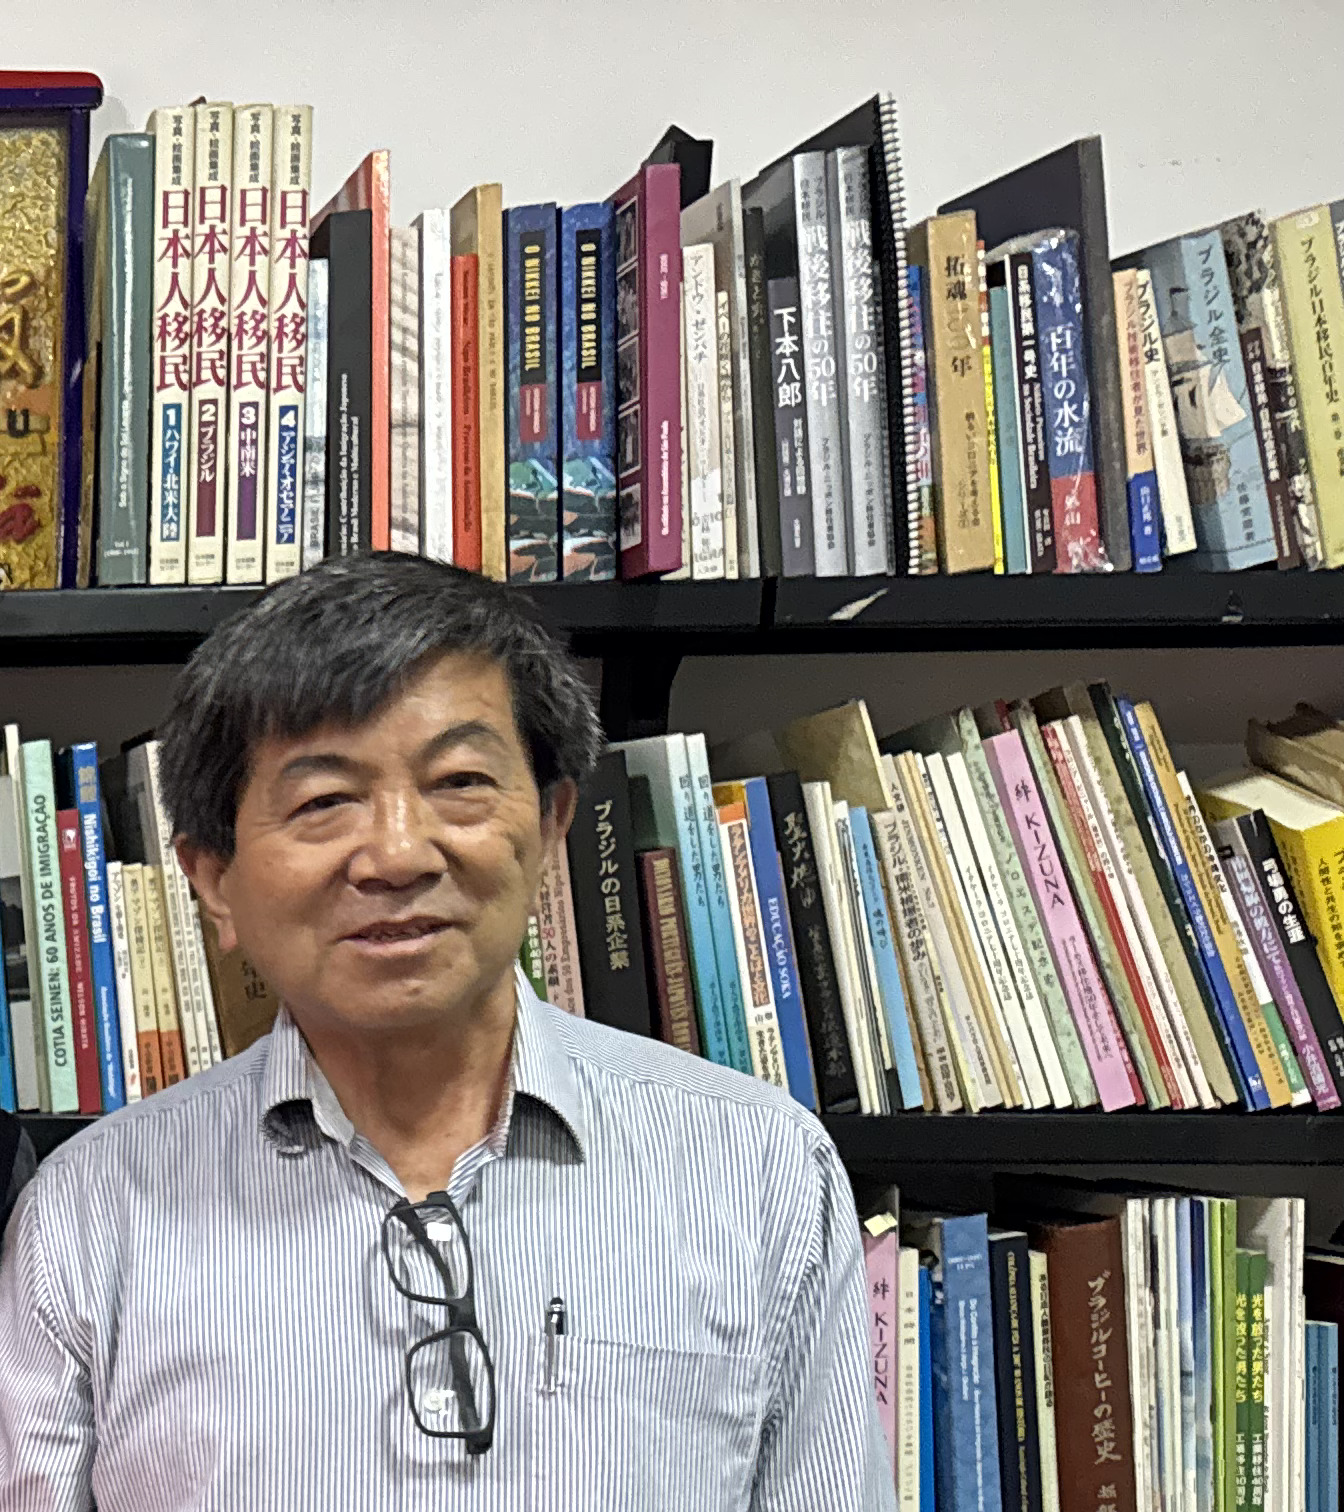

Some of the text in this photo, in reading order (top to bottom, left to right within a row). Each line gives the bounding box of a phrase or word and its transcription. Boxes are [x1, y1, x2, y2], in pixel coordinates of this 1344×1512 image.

[157, 190, 191, 392] 日本人移民
[192, 185, 228, 390] 日本人移民
[233, 186, 269, 391] 日本人移民
[524, 245, 540, 253] O
[524, 257, 540, 300] NIKKEI
[580, 243, 596, 251] O
[580, 256, 596, 299] NIKKEI
[272, 189, 309, 394] 日本人移民
[524, 304, 540, 322] NO
[580, 303, 596, 321] NO
[1137, 281, 1160, 363] ブラジル史
[524, 326, 540, 371] BRASIL
[580, 324, 596, 369] BRASIL
[773, 306, 802, 408] 下本八郎
[167, 409, 176, 425] 1
[280, 409, 296, 428] 4
[1048, 327, 1083, 456] 百年の水流
[200, 404, 216, 484] 2 ブラジル
[239, 407, 256, 477] 3 中南米
[80, 813, 109, 943] Nishikigoi no Brasil
[595, 800, 630, 970] ブラジルの日系企業
[1025, 814, 1065, 908] KIZUNA
[29, 794, 69, 1066] COTIA SEINEN: 60 ANOS DE IMIGRAÇÃO
[765, 896, 791, 998] EDUCAÇÃO SOKA
[873, 1311, 890, 1405] KIZUNA
[1087, 1271, 1121, 1464] ブラジルコーヒーの歴史
